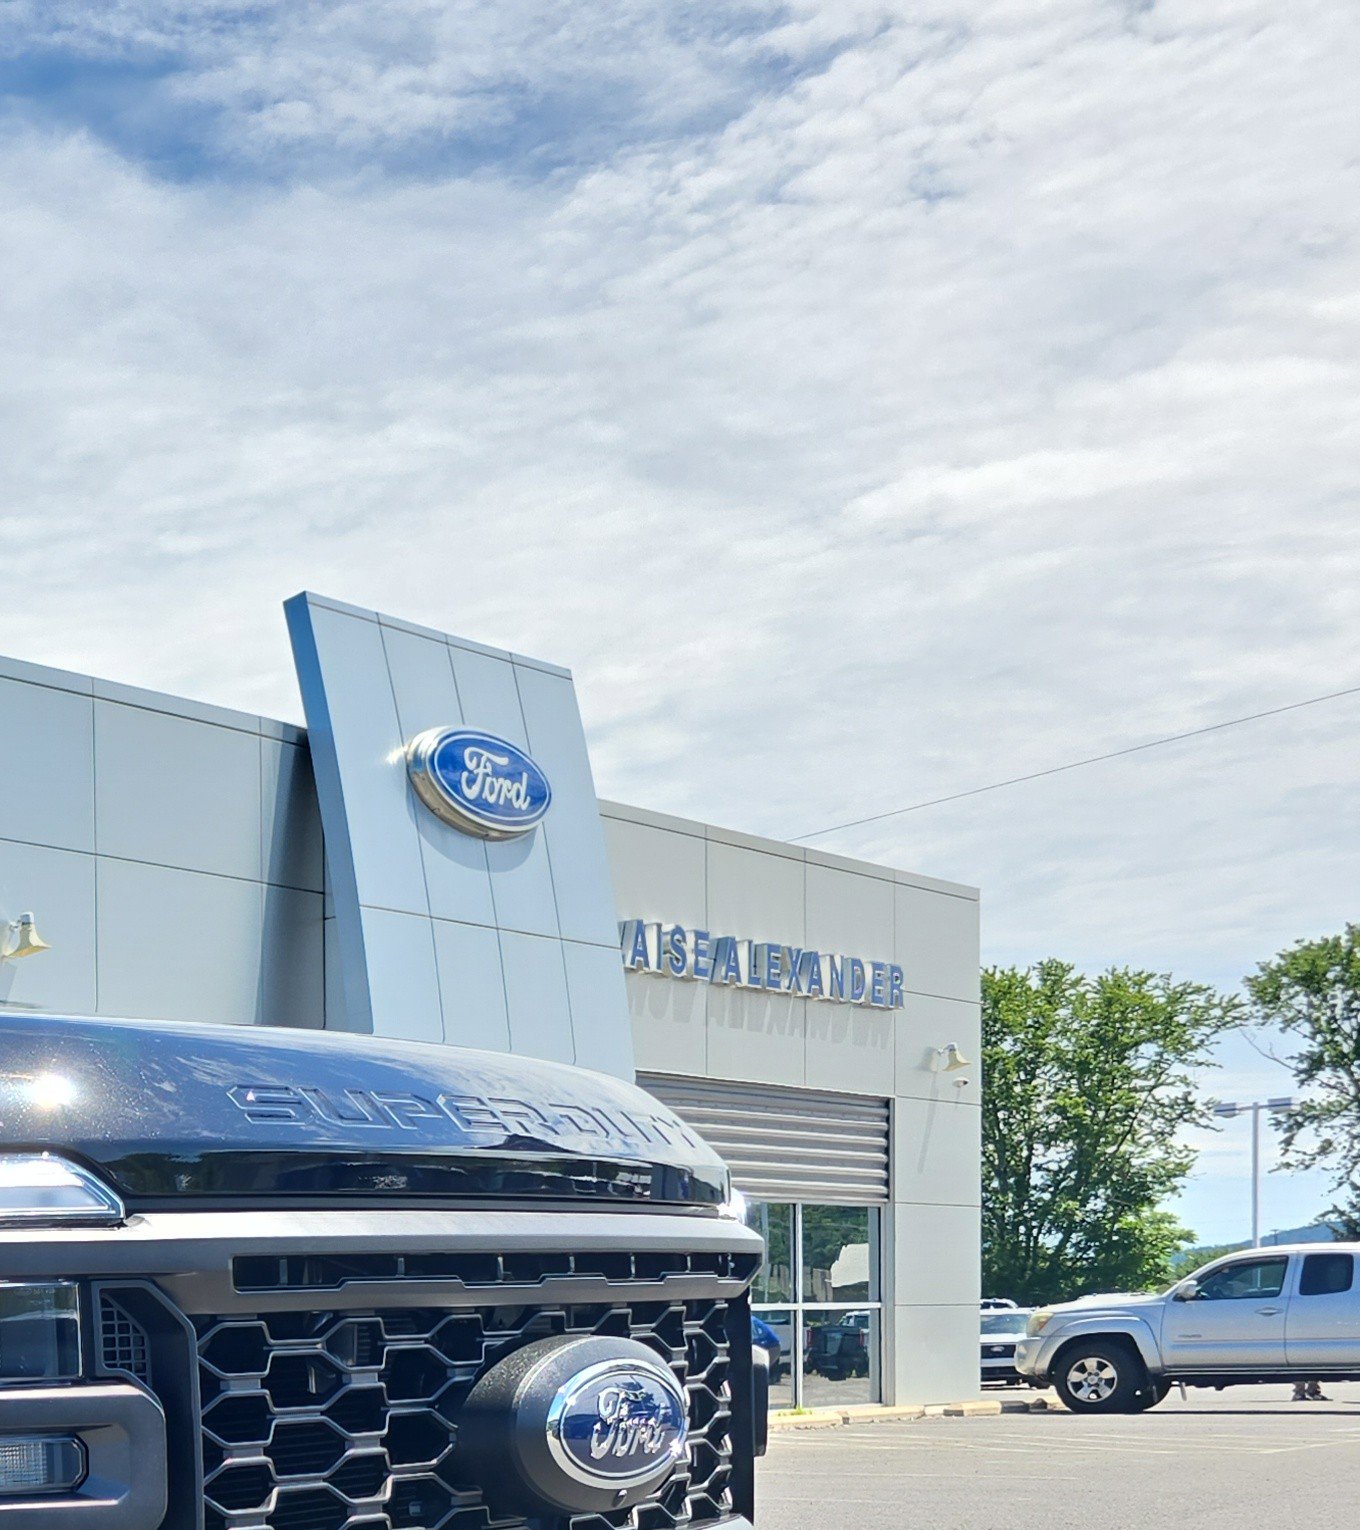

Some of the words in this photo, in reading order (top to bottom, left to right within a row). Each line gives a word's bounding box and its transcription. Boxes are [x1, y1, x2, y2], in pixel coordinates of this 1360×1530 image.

[460, 746, 530, 810] Ford
[711, 936, 905, 1009] ALEXANDER
[590, 1387, 666, 1459] Ford
